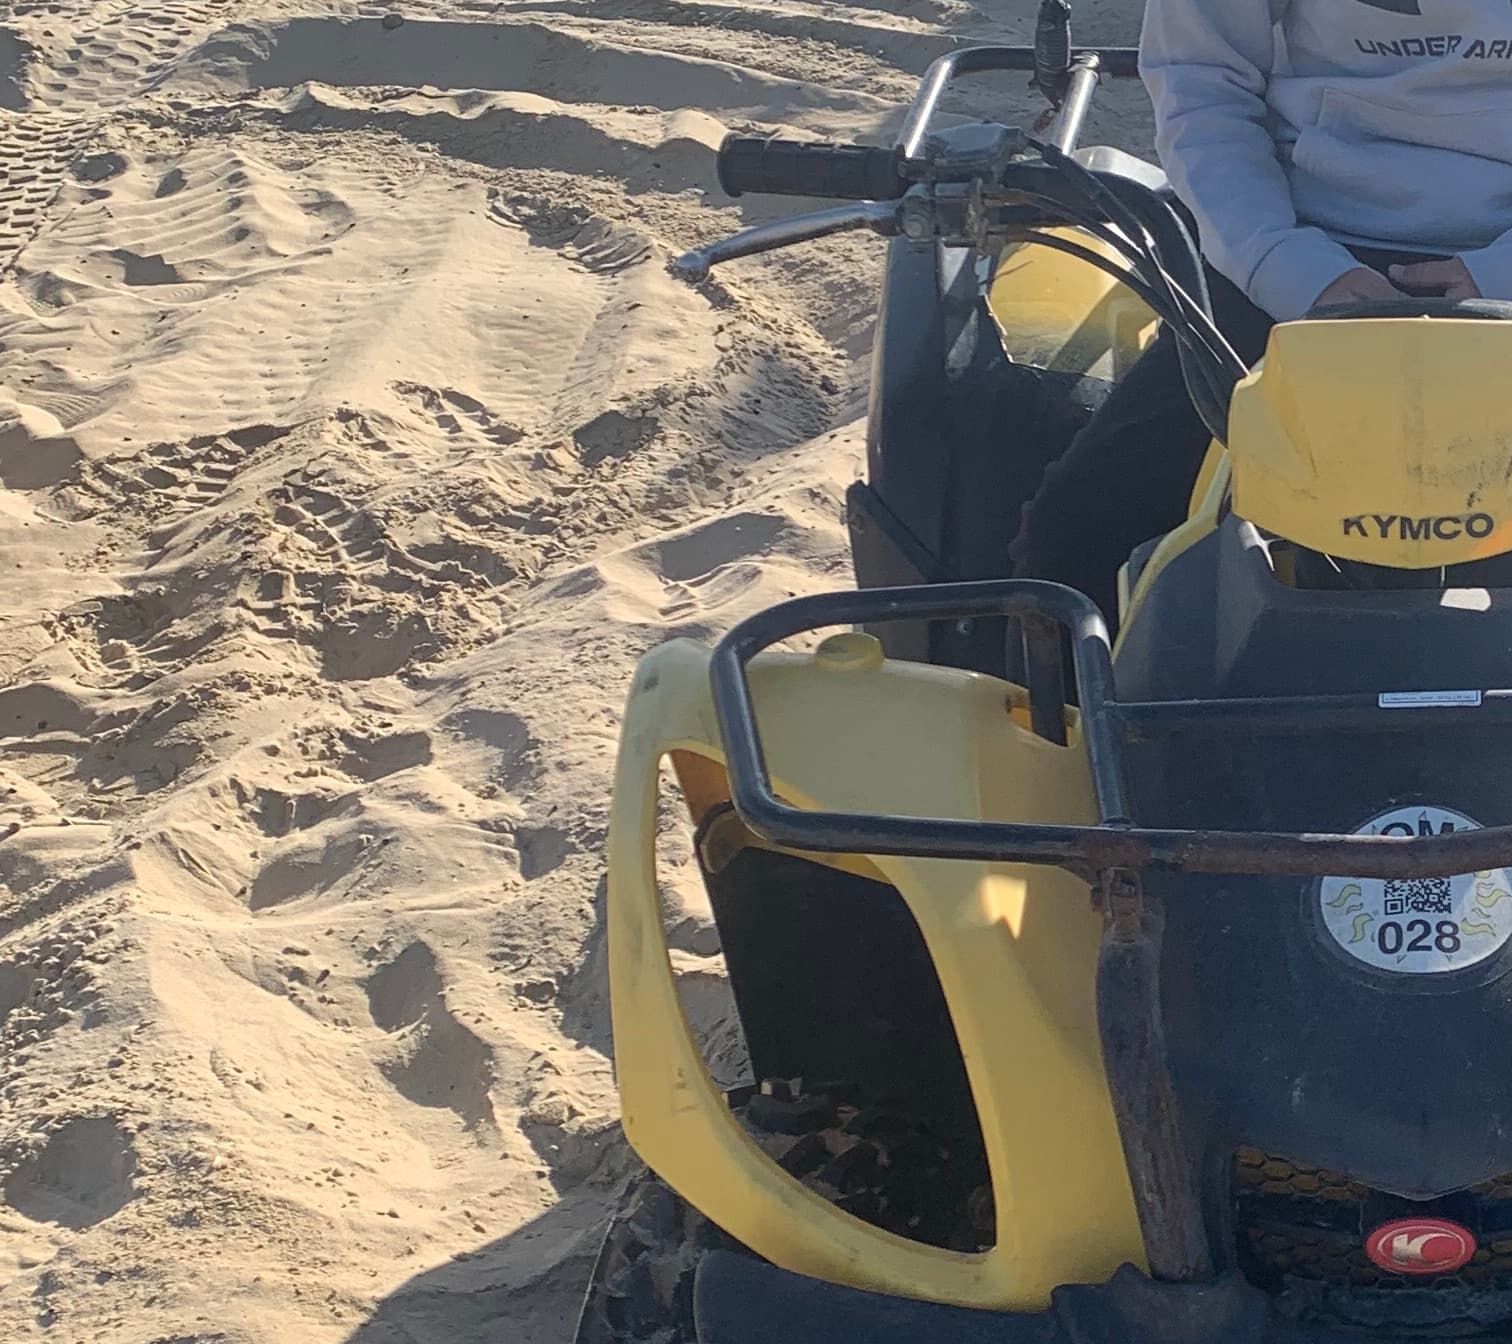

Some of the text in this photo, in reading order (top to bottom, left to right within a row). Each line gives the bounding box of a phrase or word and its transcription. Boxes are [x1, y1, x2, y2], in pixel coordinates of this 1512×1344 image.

[1355, 35, 1462, 57] UNDER
[1342, 512, 1494, 541] KYMCO
[1378, 920, 1461, 955] 028
